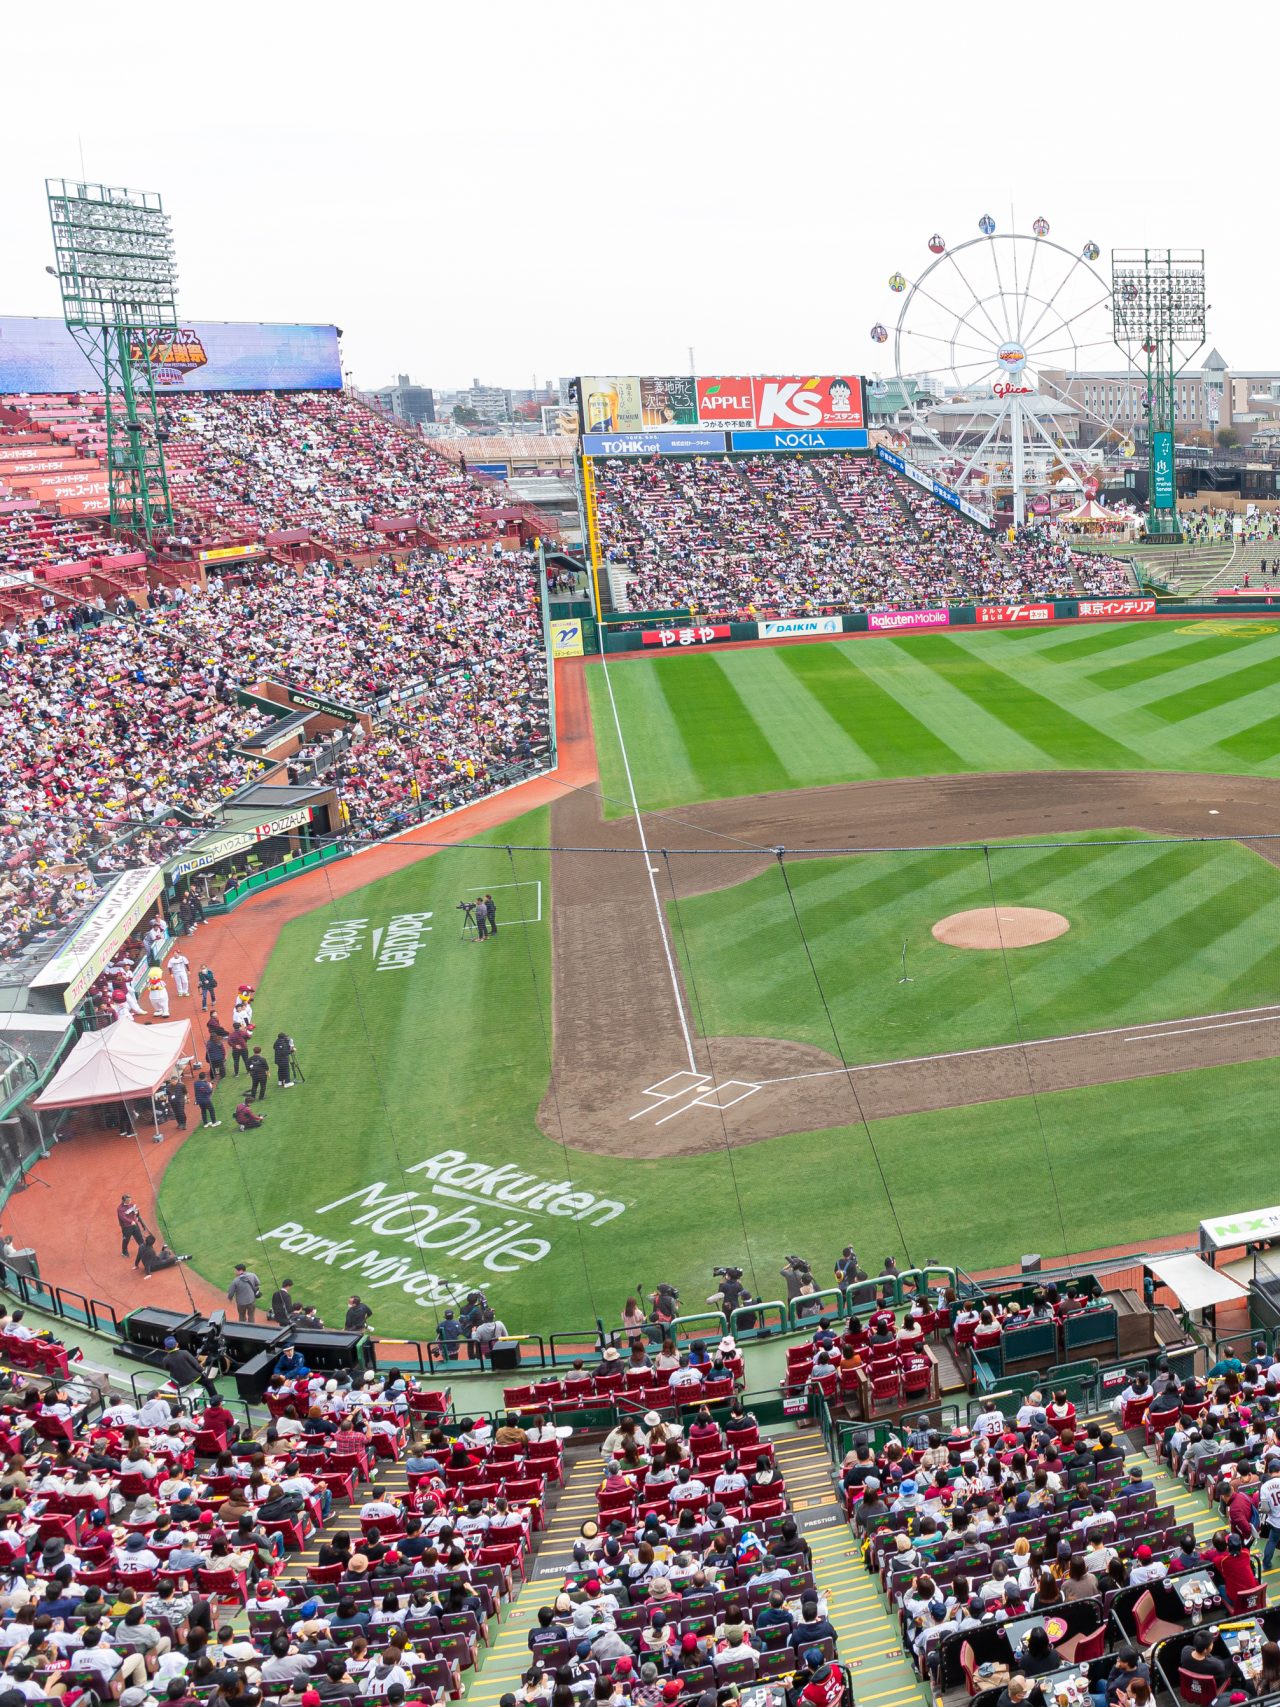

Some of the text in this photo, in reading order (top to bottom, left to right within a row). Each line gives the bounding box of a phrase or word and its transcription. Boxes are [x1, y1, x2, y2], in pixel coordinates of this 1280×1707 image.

[644, 380, 692, 394] 三菱地所と
[993, 383, 1034, 398] Glico
[645, 394, 694, 408] 次にいこう。
[701, 396, 751, 410] APPLE
[703, 420, 752, 428] つがるや不動産
[775, 434, 825, 447] NOKIA
[15, 462, 63, 472] アサヒスーパードライ
[41, 474, 89, 484] アサヒスーパードライ
[982, 607, 1003, 615] クルマ
[1079, 601, 1155, 616] 東京インテリア
[871, 611, 946, 628] Rakuten Mobile
[776, 622, 818, 633] DAIKIN
[658, 626, 716, 647] やまや
[314, 918, 369, 963] Mobile
[376, 911, 434, 971] Rakuten
[405, 1149, 627, 1228] Rakuten
[315, 1181, 551, 1272] Mobile
[1214, 1218, 1270, 1236] NX
[256, 1221, 492, 1308] Park Miyagi
[986, 1419, 1003, 1433] 33
[804, 1515, 837, 1527] PRESTIGE
